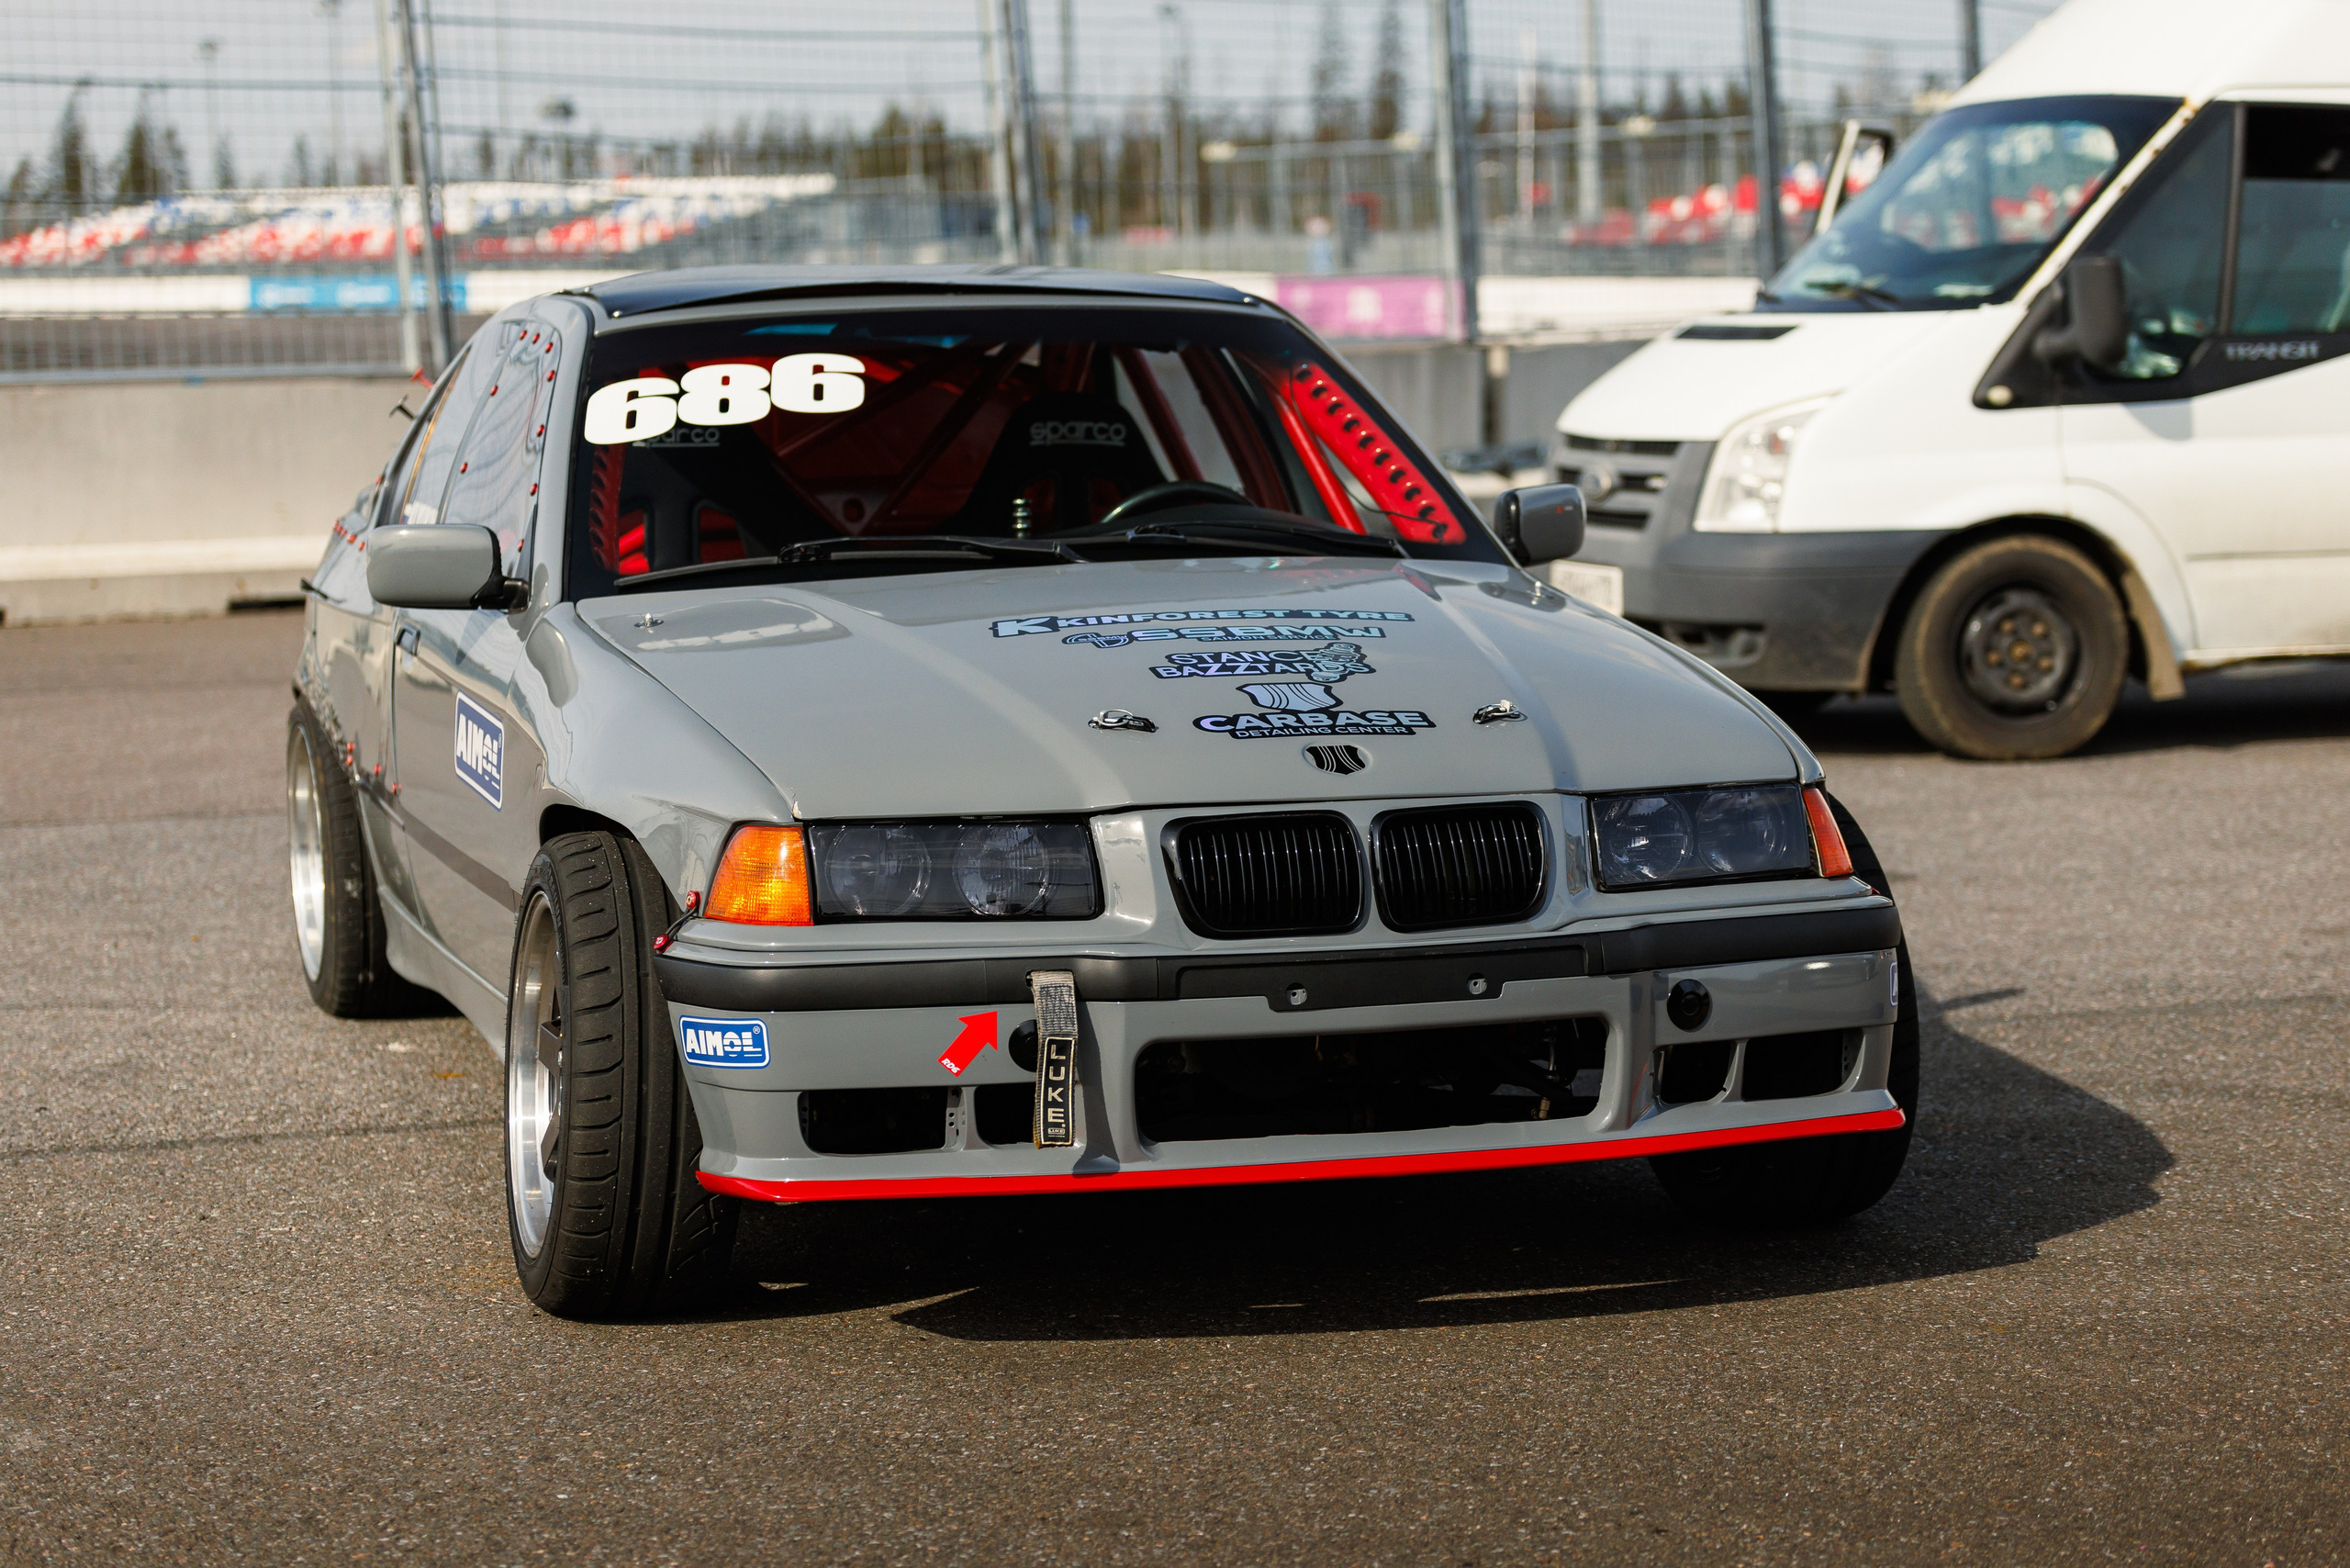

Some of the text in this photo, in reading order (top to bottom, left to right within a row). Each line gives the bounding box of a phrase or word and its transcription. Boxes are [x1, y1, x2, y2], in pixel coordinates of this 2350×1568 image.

[584, 353, 866, 444] 686
[1058, 610, 1290, 627] KINFOREST
[1302, 610, 1410, 622] TYRE
[1131, 625, 1382, 641] SSBMW
[1170, 649, 1330, 665] STANCE
[1155, 660, 1370, 678] BAZZTARDS
[1200, 711, 1429, 732] CARBASE
[1235, 725, 1409, 737] DETAILING CENTER
[456, 712, 501, 791] AIMOL
[686, 1028, 763, 1058] AIMOL
[940, 1058, 961, 1074] RDS
